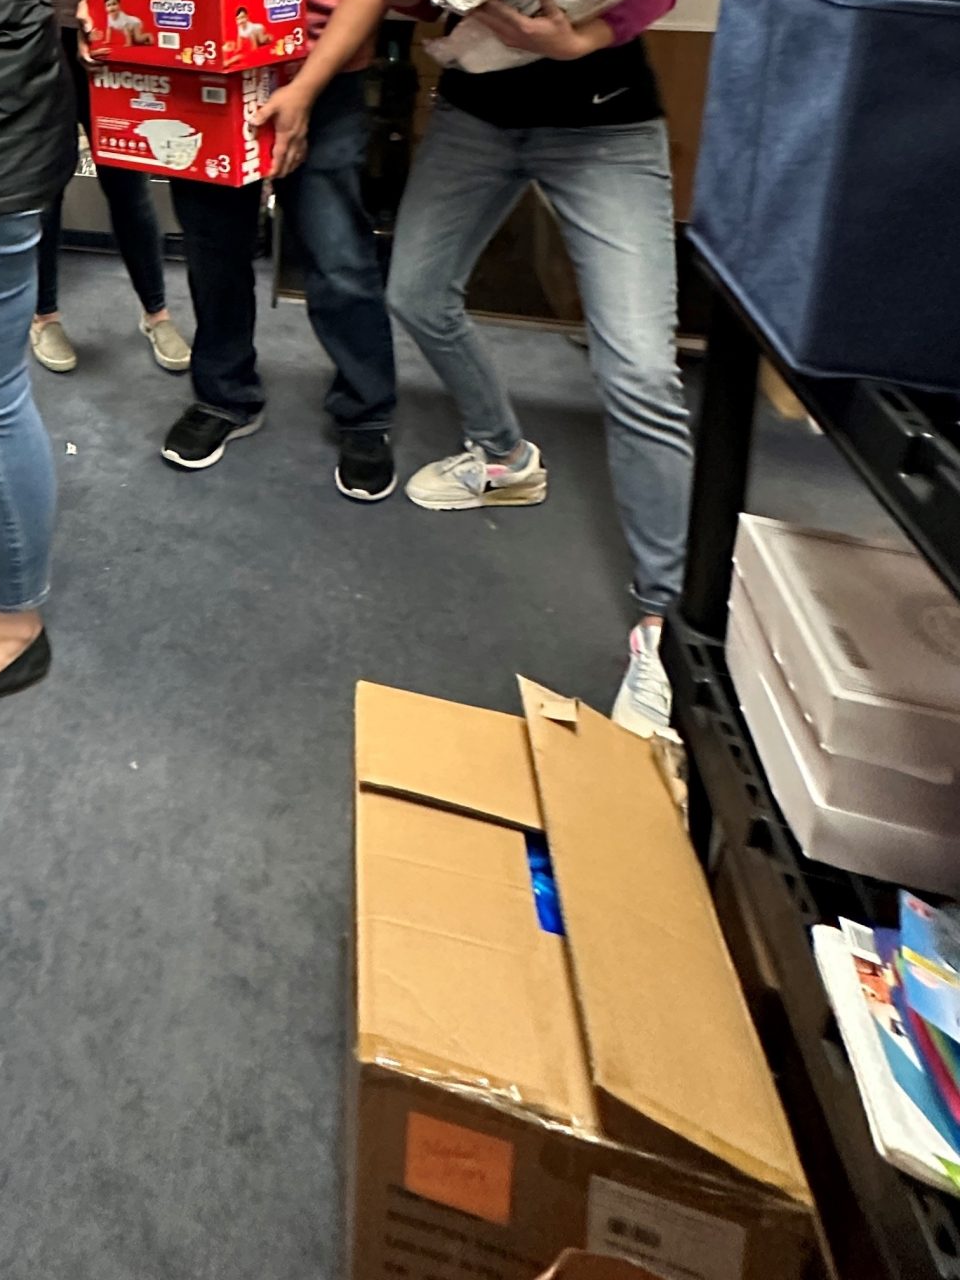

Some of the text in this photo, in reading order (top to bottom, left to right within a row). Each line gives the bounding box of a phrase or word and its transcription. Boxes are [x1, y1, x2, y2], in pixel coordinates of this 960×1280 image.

[152, 1, 193, 12] movers
[293, 27, 304, 45] 3
[204, 41, 217, 59] 3
[93, 66, 171, 94] HUGGIES
[218, 154, 231, 173] 3
